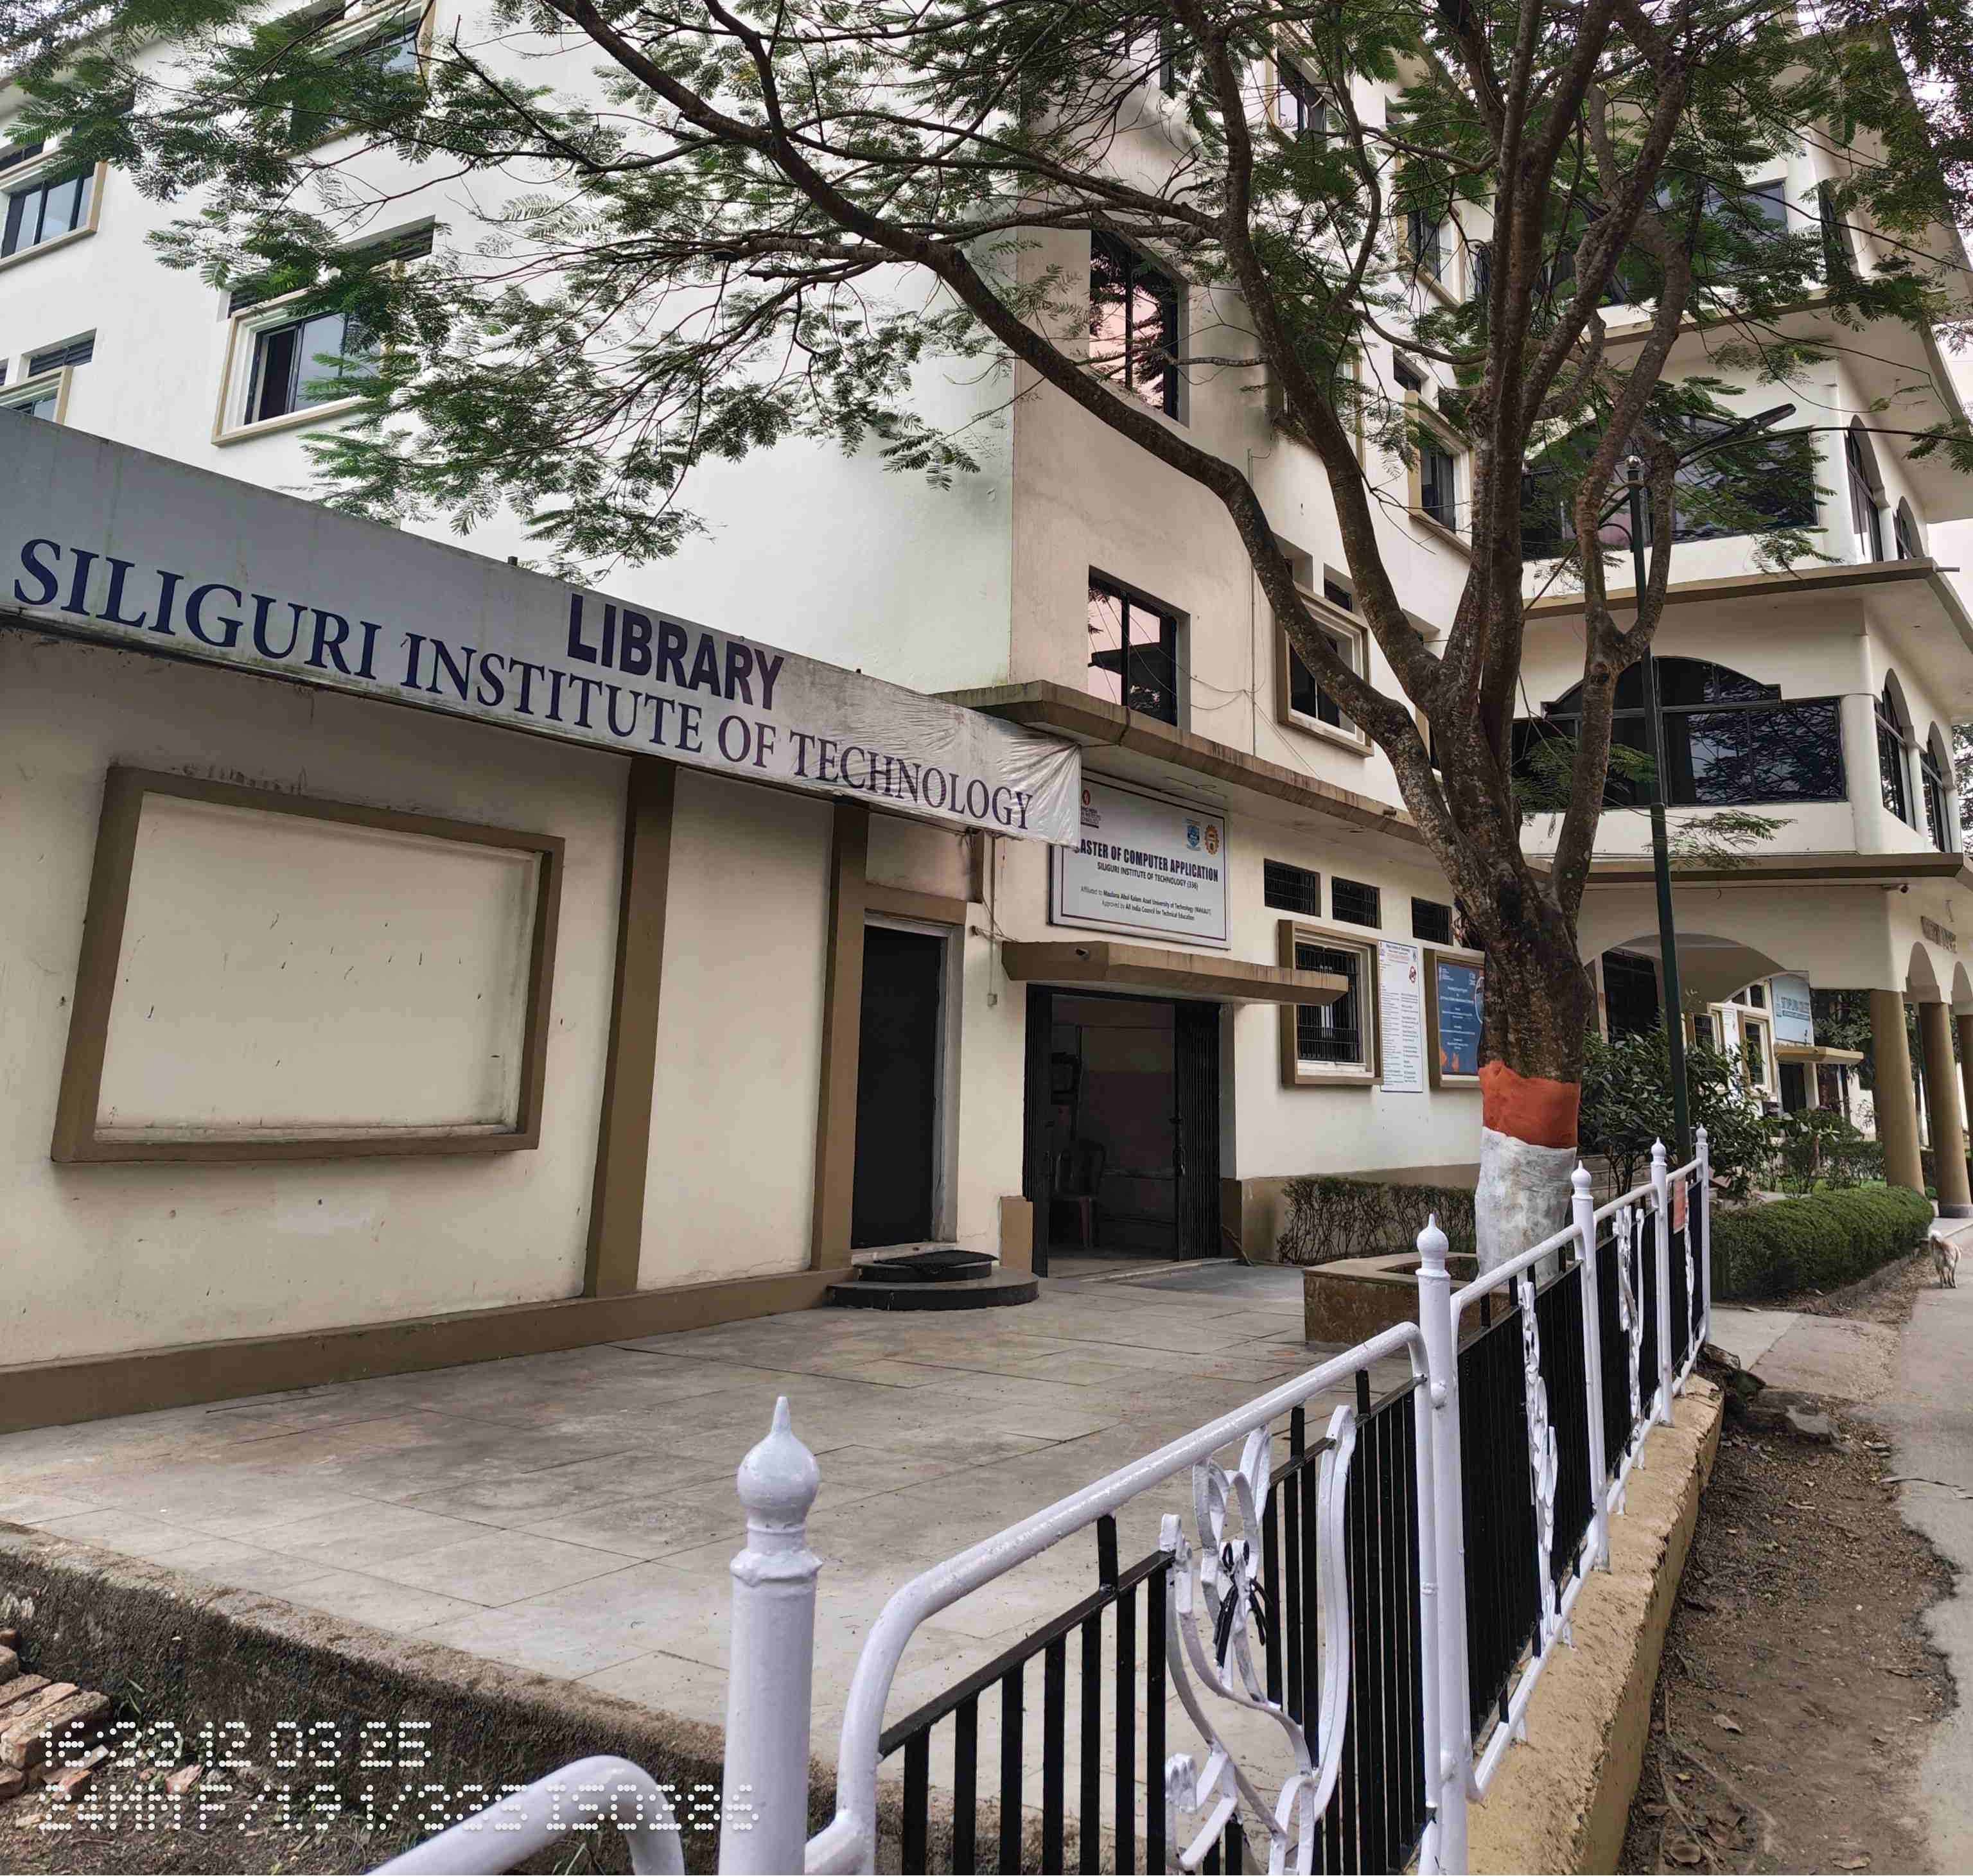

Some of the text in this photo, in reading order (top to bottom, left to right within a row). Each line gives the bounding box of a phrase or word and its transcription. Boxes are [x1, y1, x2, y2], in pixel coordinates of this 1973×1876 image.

[567, 593, 785, 710] LIBRARY
[14, 538, 1033, 830] SILIGURI INSTITUTE OF TECHNOLOGY
[1097, 862, 1119, 873] SILIGURI
[1121, 868, 1146, 880] INSTITUTE
[1147, 872, 1153, 881] OF
[1155, 874, 1186, 888] TECHNOLOGY
[1110, 846, 1122, 862] OF
[1124, 848, 1168, 872] COMPUTER
[1170, 858, 1218, 882] APPLICATION
[1141, 906, 1155, 914] Council
[1162, 909, 1177, 918] Technical
[1178, 911, 1195, 920] Education
[1152, 899, 1170, 909] University
[1174, 903, 1194, 913] Technology
